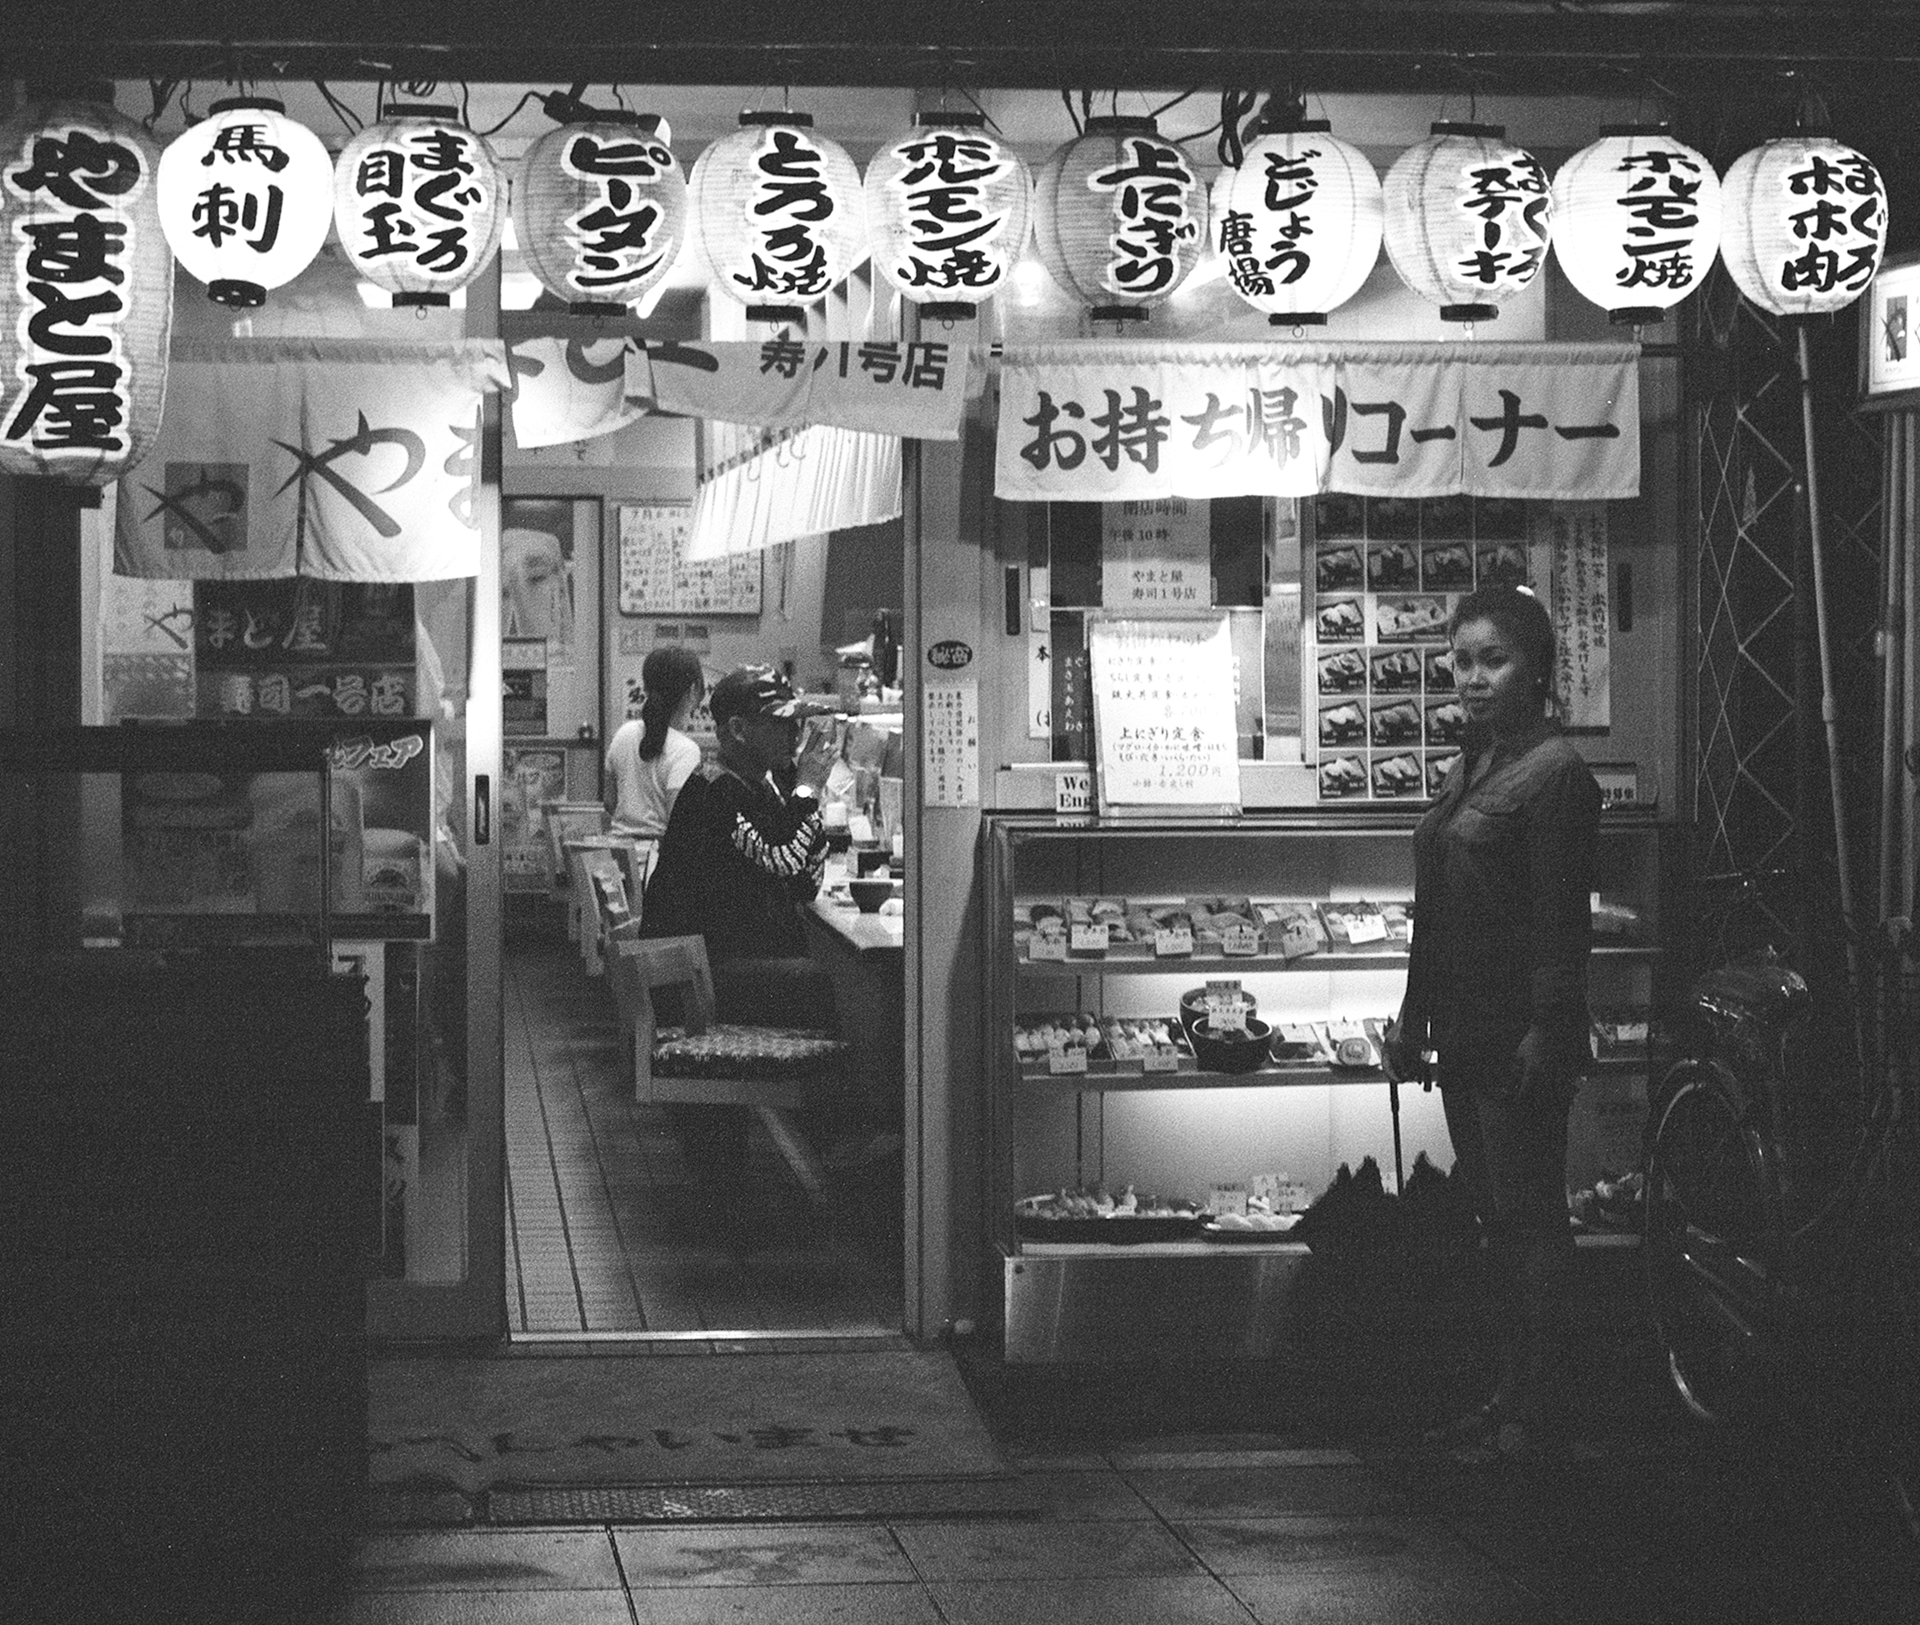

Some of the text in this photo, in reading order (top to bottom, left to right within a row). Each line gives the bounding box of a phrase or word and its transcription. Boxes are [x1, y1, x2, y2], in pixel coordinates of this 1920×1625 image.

[191, 124, 290, 253] 馬刺
[356, 150, 419, 260] 目玉
[410, 130, 482, 272] まぐろ
[569, 136, 672, 287] ピータン
[897, 136, 1001, 288] ホルモン焼
[1096, 141, 1196, 292] 上にぎり
[1264, 149, 1322, 285] どじょう
[1781, 156, 1848, 293] ホホ肉
[1836, 153, 1886, 292] まぐろ
[5, 130, 141, 452] やまと屋
[1020, 385, 1621, 473] お持ち帰りコーナー
[1131, 570, 1184, 583] やまと屋
[1119, 726, 1205, 742] 上にぎり定食
